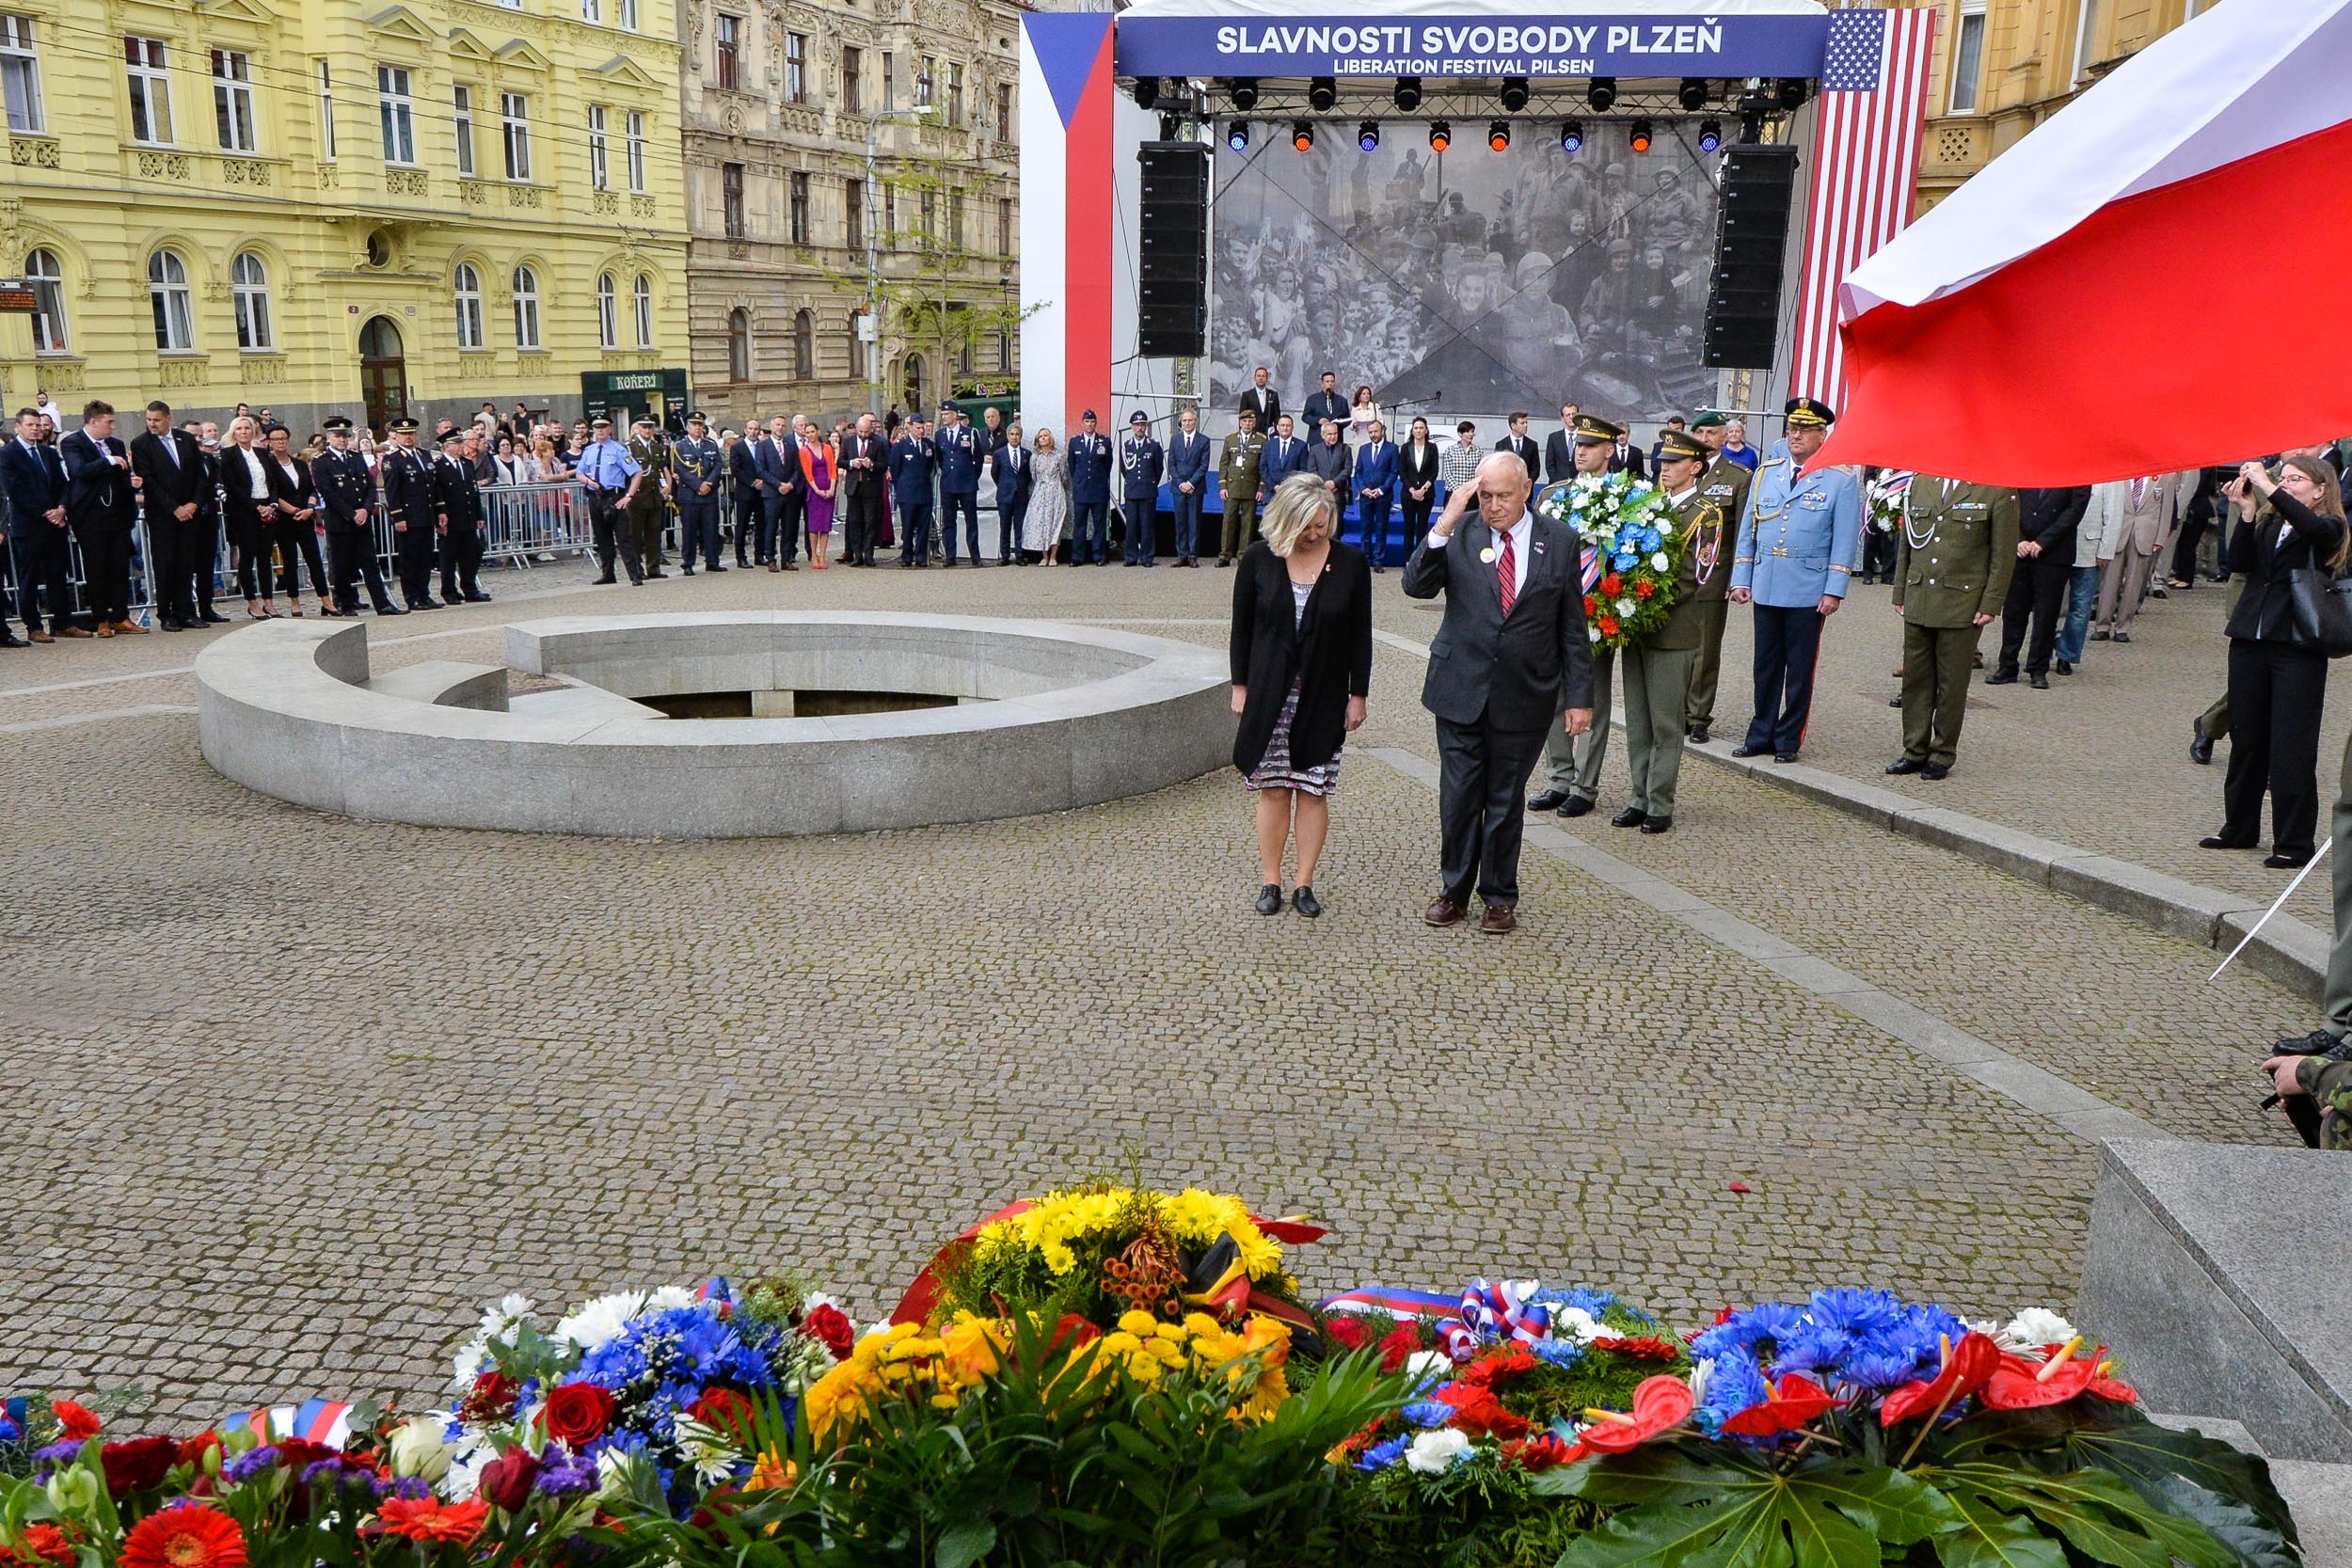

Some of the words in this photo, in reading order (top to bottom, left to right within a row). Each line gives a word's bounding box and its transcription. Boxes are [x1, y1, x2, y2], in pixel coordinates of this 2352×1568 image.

[1216, 26, 1411, 54] SLAVNOSTI
[1422, 25, 1598, 54] SVOBODY
[1607, 17, 1723, 53] PLZEŇ
[1333, 58, 1438, 74] LIBERATION
[1442, 58, 1526, 74] FESTIVAL
[1531, 58, 1595, 74] PILSEN
